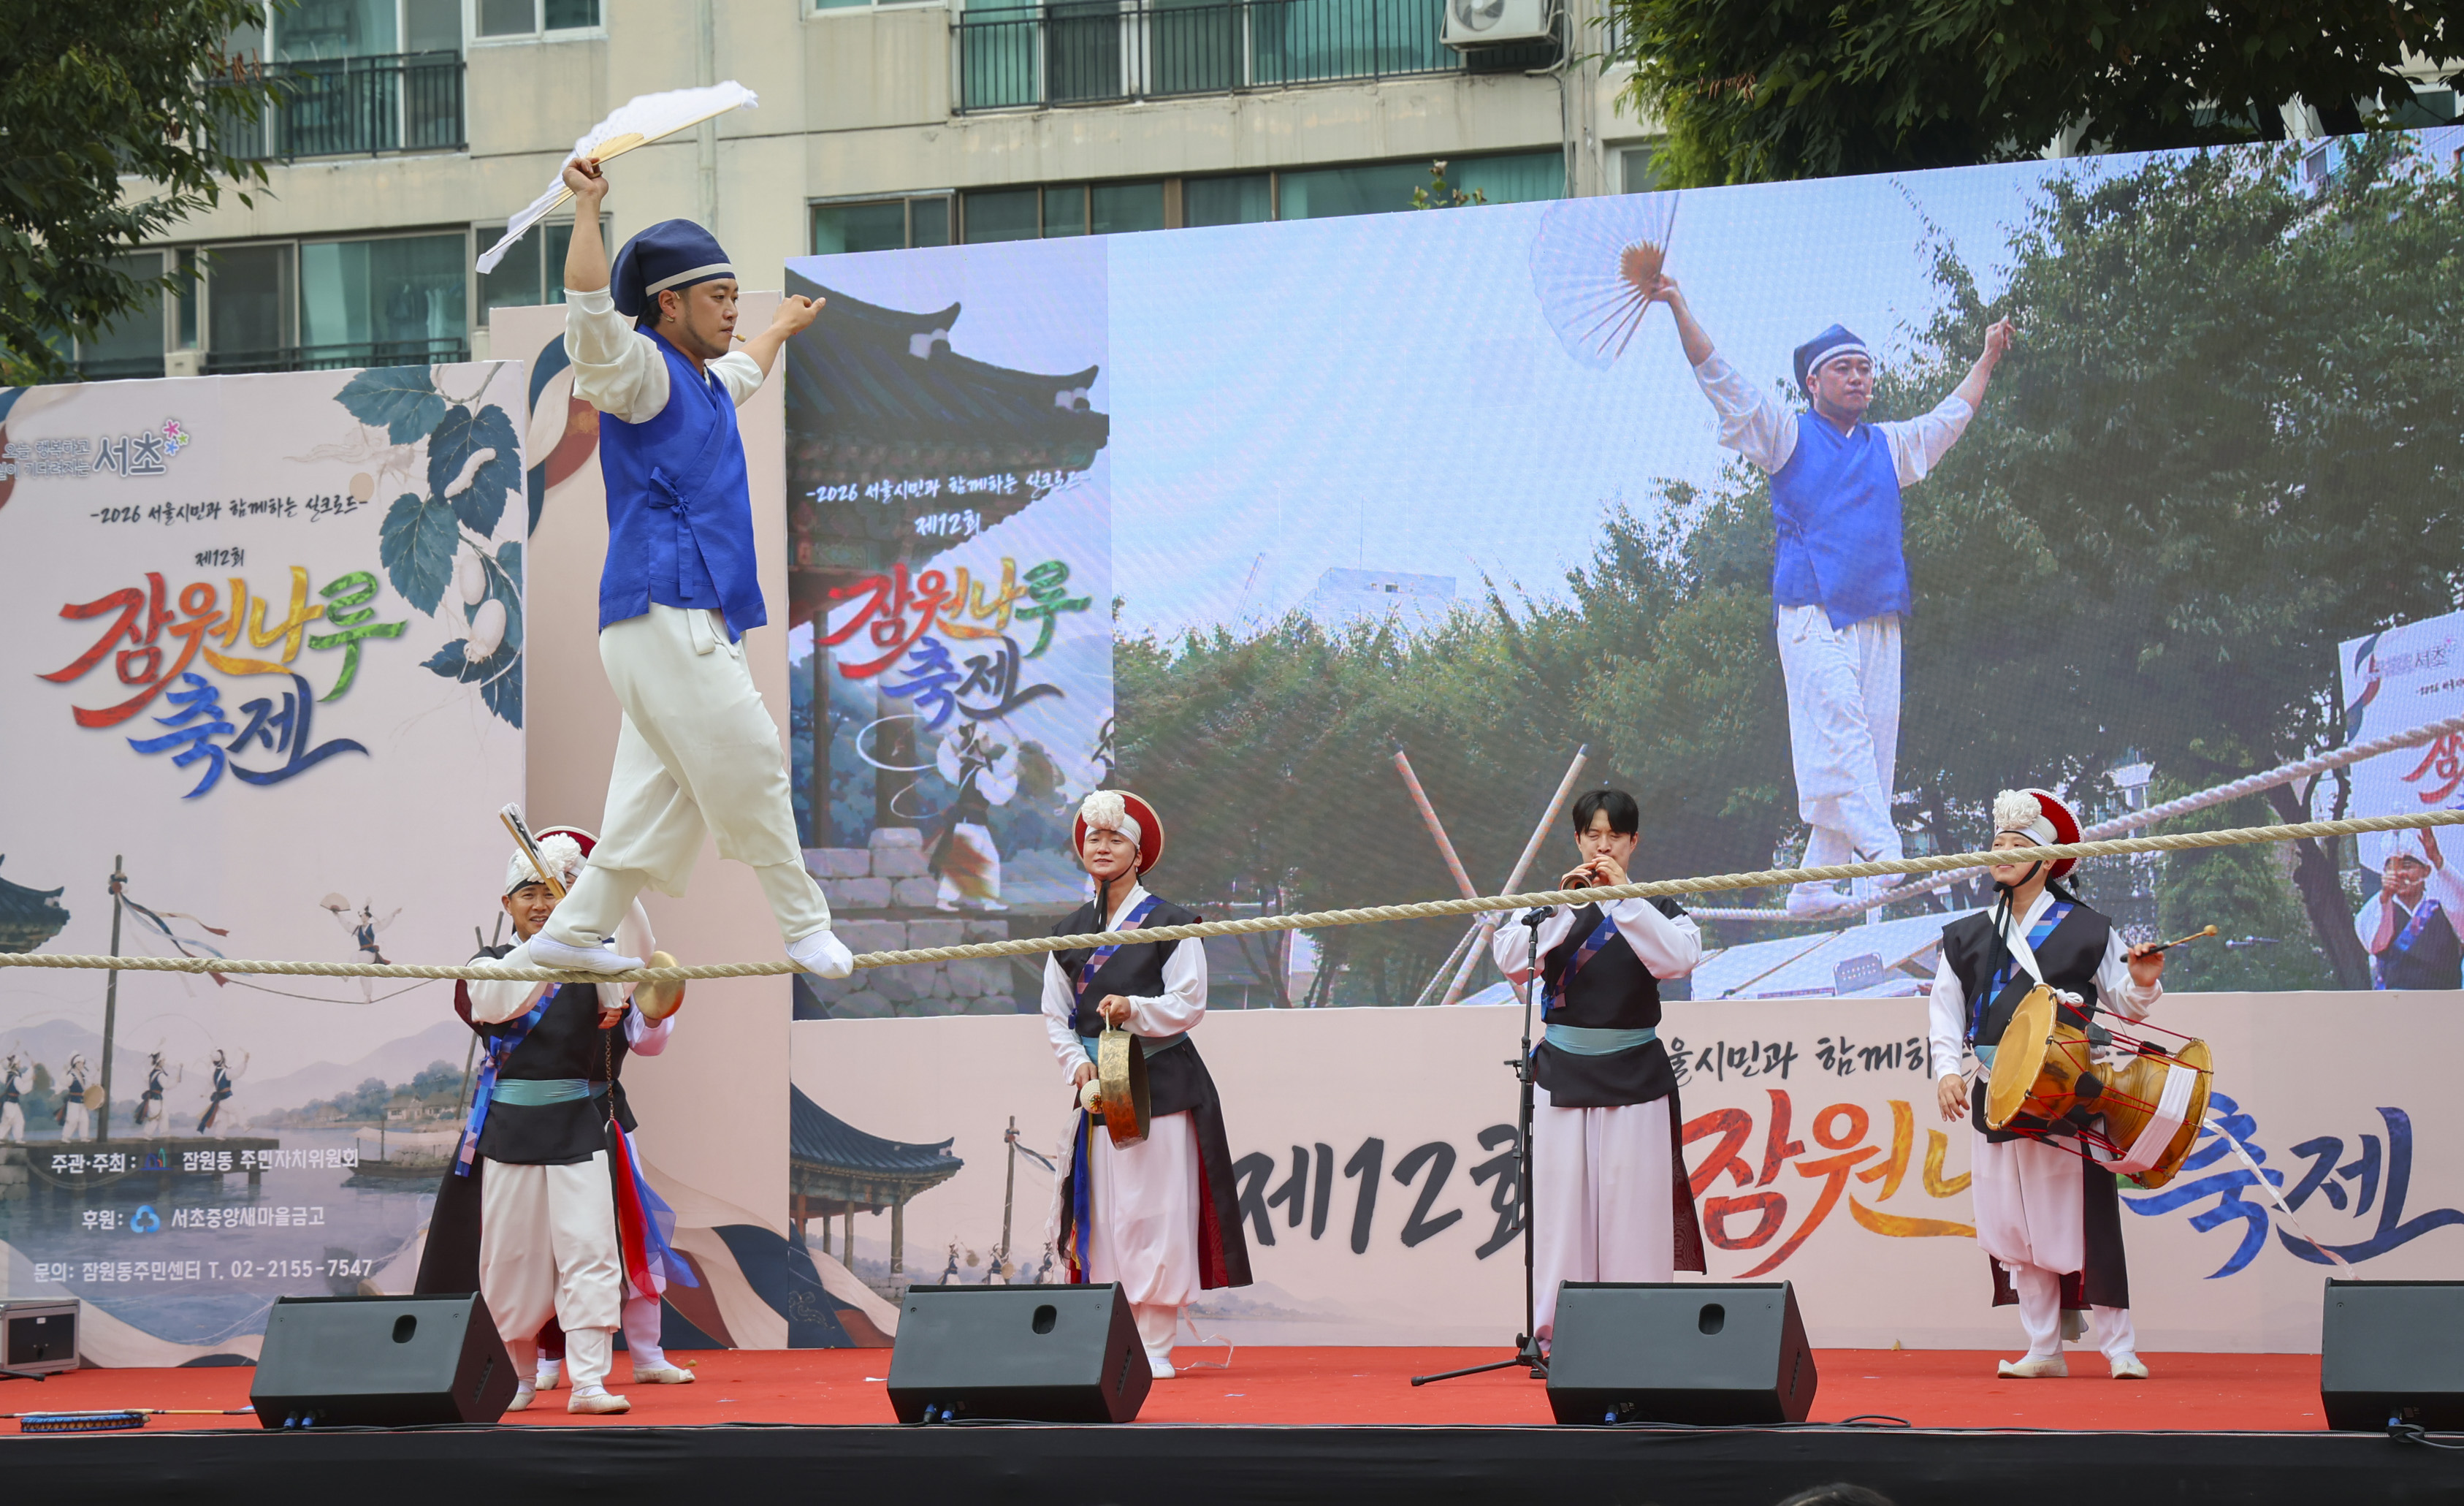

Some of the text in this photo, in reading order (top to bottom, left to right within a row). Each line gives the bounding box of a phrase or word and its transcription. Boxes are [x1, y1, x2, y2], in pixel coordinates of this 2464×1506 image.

[2, 438, 91, 460] 오늘 행복하고
[93, 431, 167, 477] 서초
[24, 459, 91, 479] 기다려지는
[806, 484, 858, 503] -2026
[865, 479, 941, 504] 서울시민과
[948, 474, 1018, 495] 함께하는
[91, 505, 141, 524] -2026
[148, 501, 221, 526] 서울시민과
[229, 497, 297, 519] 함께하는
[915, 509, 981, 536] 제12회
[194, 547, 245, 568] 제12회
[813, 557, 1091, 679] 잠원나루
[34, 565, 408, 728] 잠원나루
[880, 636, 1065, 731] 축제
[125, 672, 370, 799] 축제
[1667, 1036, 1972, 1087] 울시민과 함께하
[183, 1147, 359, 1171] 잠원동 주민자치위원회
[2118, 1092, 2464, 1279] 축제
[172, 1206, 325, 1229] 서초중앙새마을금고
[34, 1258, 373, 1283] 문의: 잠원동주민센터 T. 02-2155-7547
